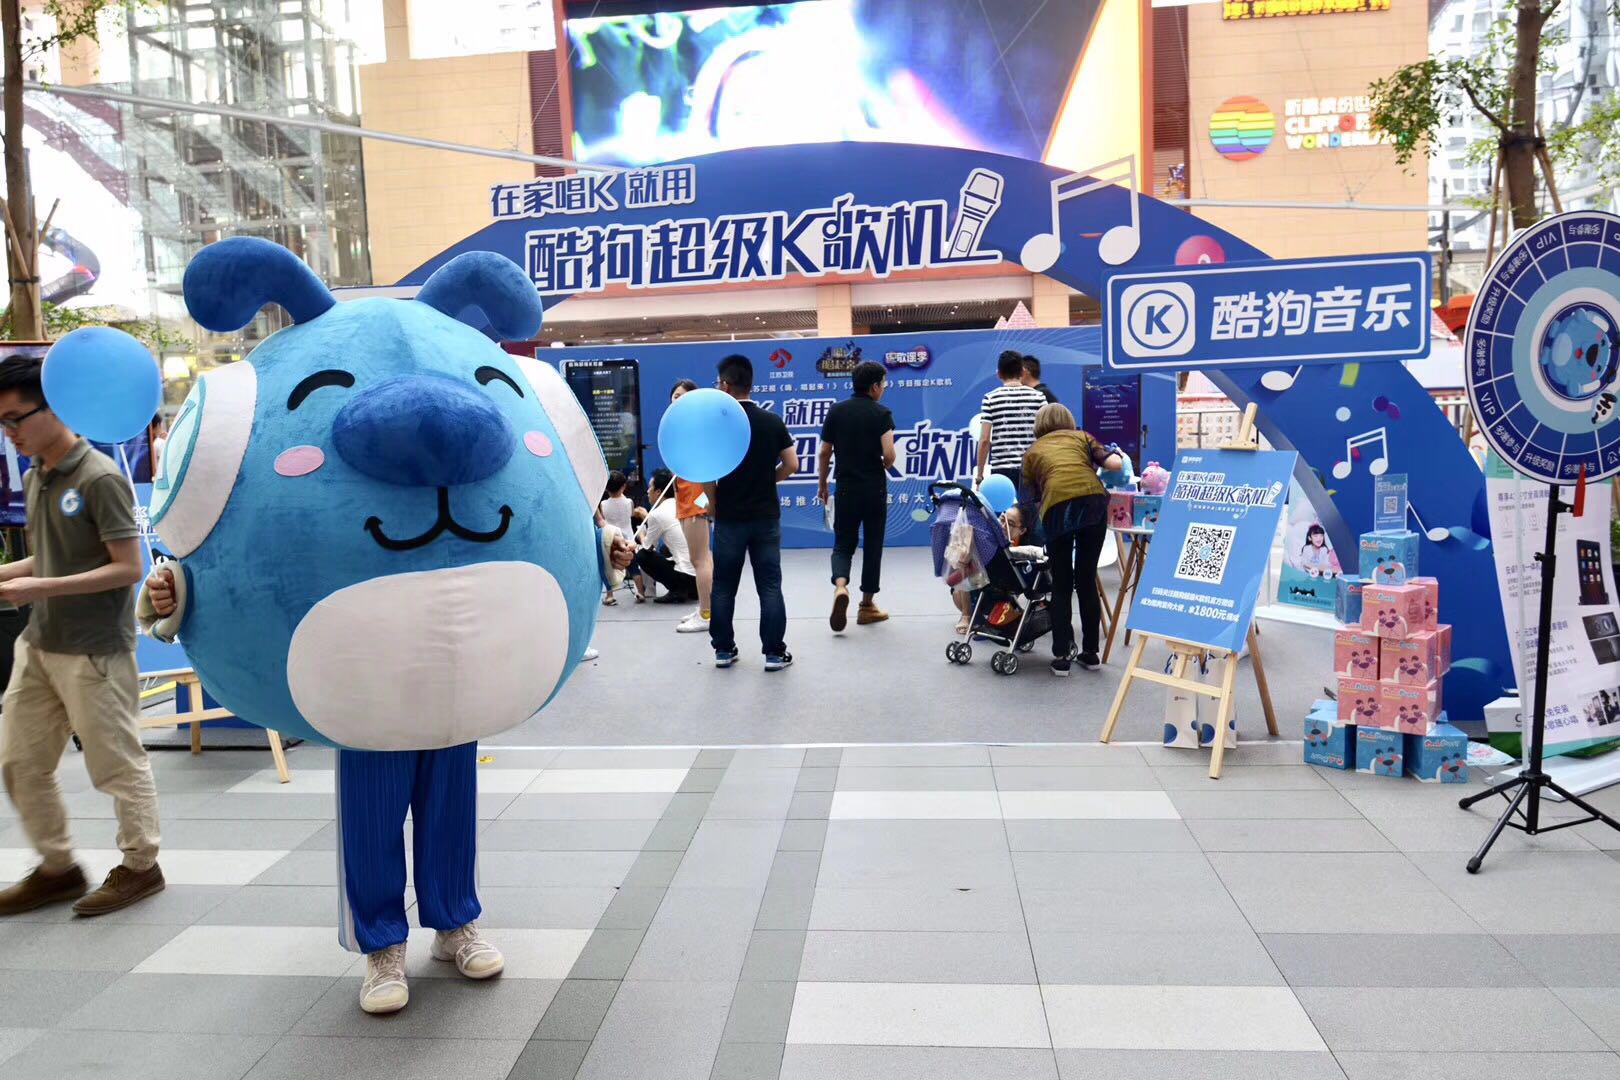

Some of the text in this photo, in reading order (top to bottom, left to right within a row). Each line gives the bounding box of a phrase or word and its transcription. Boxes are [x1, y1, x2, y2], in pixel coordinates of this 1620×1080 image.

[489, 165, 695, 217] 在家唱K 就用
[527, 196, 999, 293] 酷狗超级K歌机
[1536, 231, 1557, 250] VIP
[1145, 304, 1174, 335] K
[1210, 283, 1413, 341] 酷狗音乐
[784, 400, 834, 426] 就用
[1480, 391, 1497, 416] VIP
[1494, 425, 1521, 454] 多谢参与
[1524, 452, 1556, 473] 升级奖励
[1172, 483, 1277, 508] 酷狗超级K歌机
